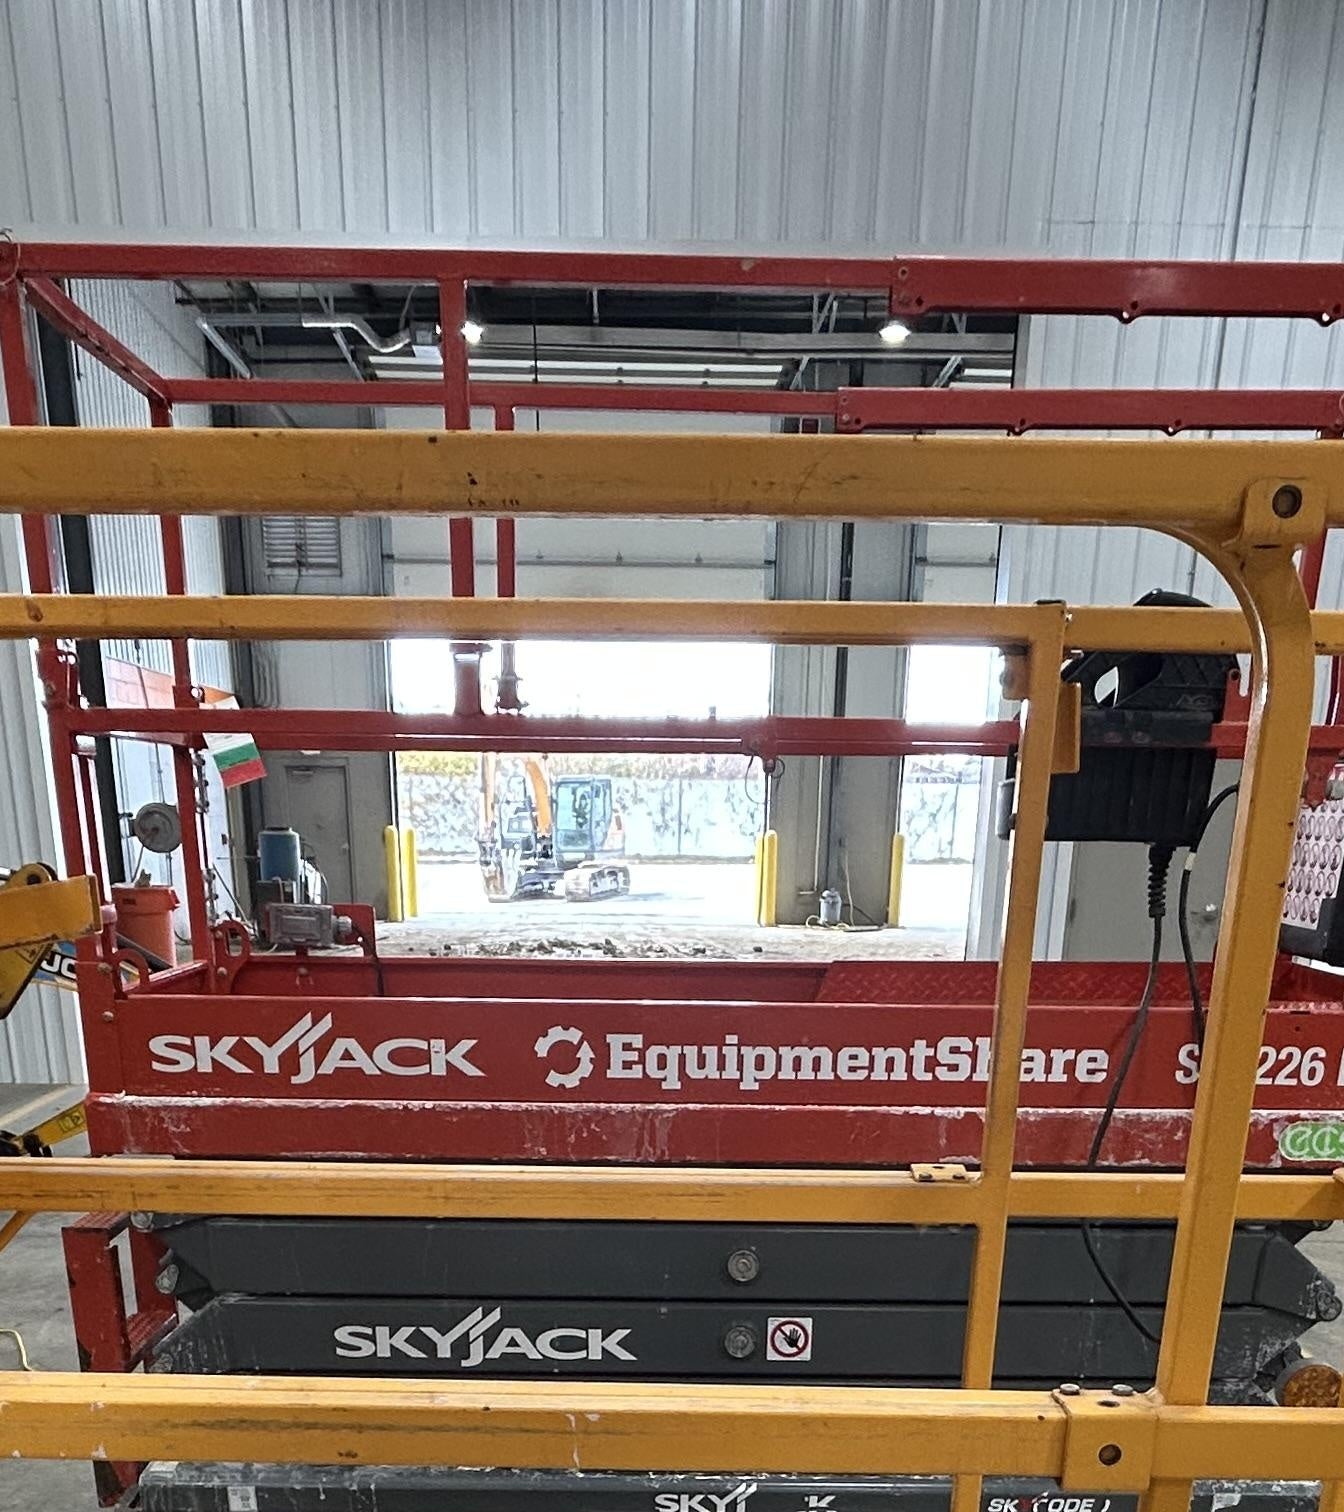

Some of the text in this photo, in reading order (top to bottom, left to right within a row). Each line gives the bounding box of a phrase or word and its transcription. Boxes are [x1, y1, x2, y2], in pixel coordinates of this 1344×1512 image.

[148, 1012, 486, 1084] SKYJACK
[1175, 1043, 1327, 1087] S226
[334, 1306, 638, 1368] SKYJACK
